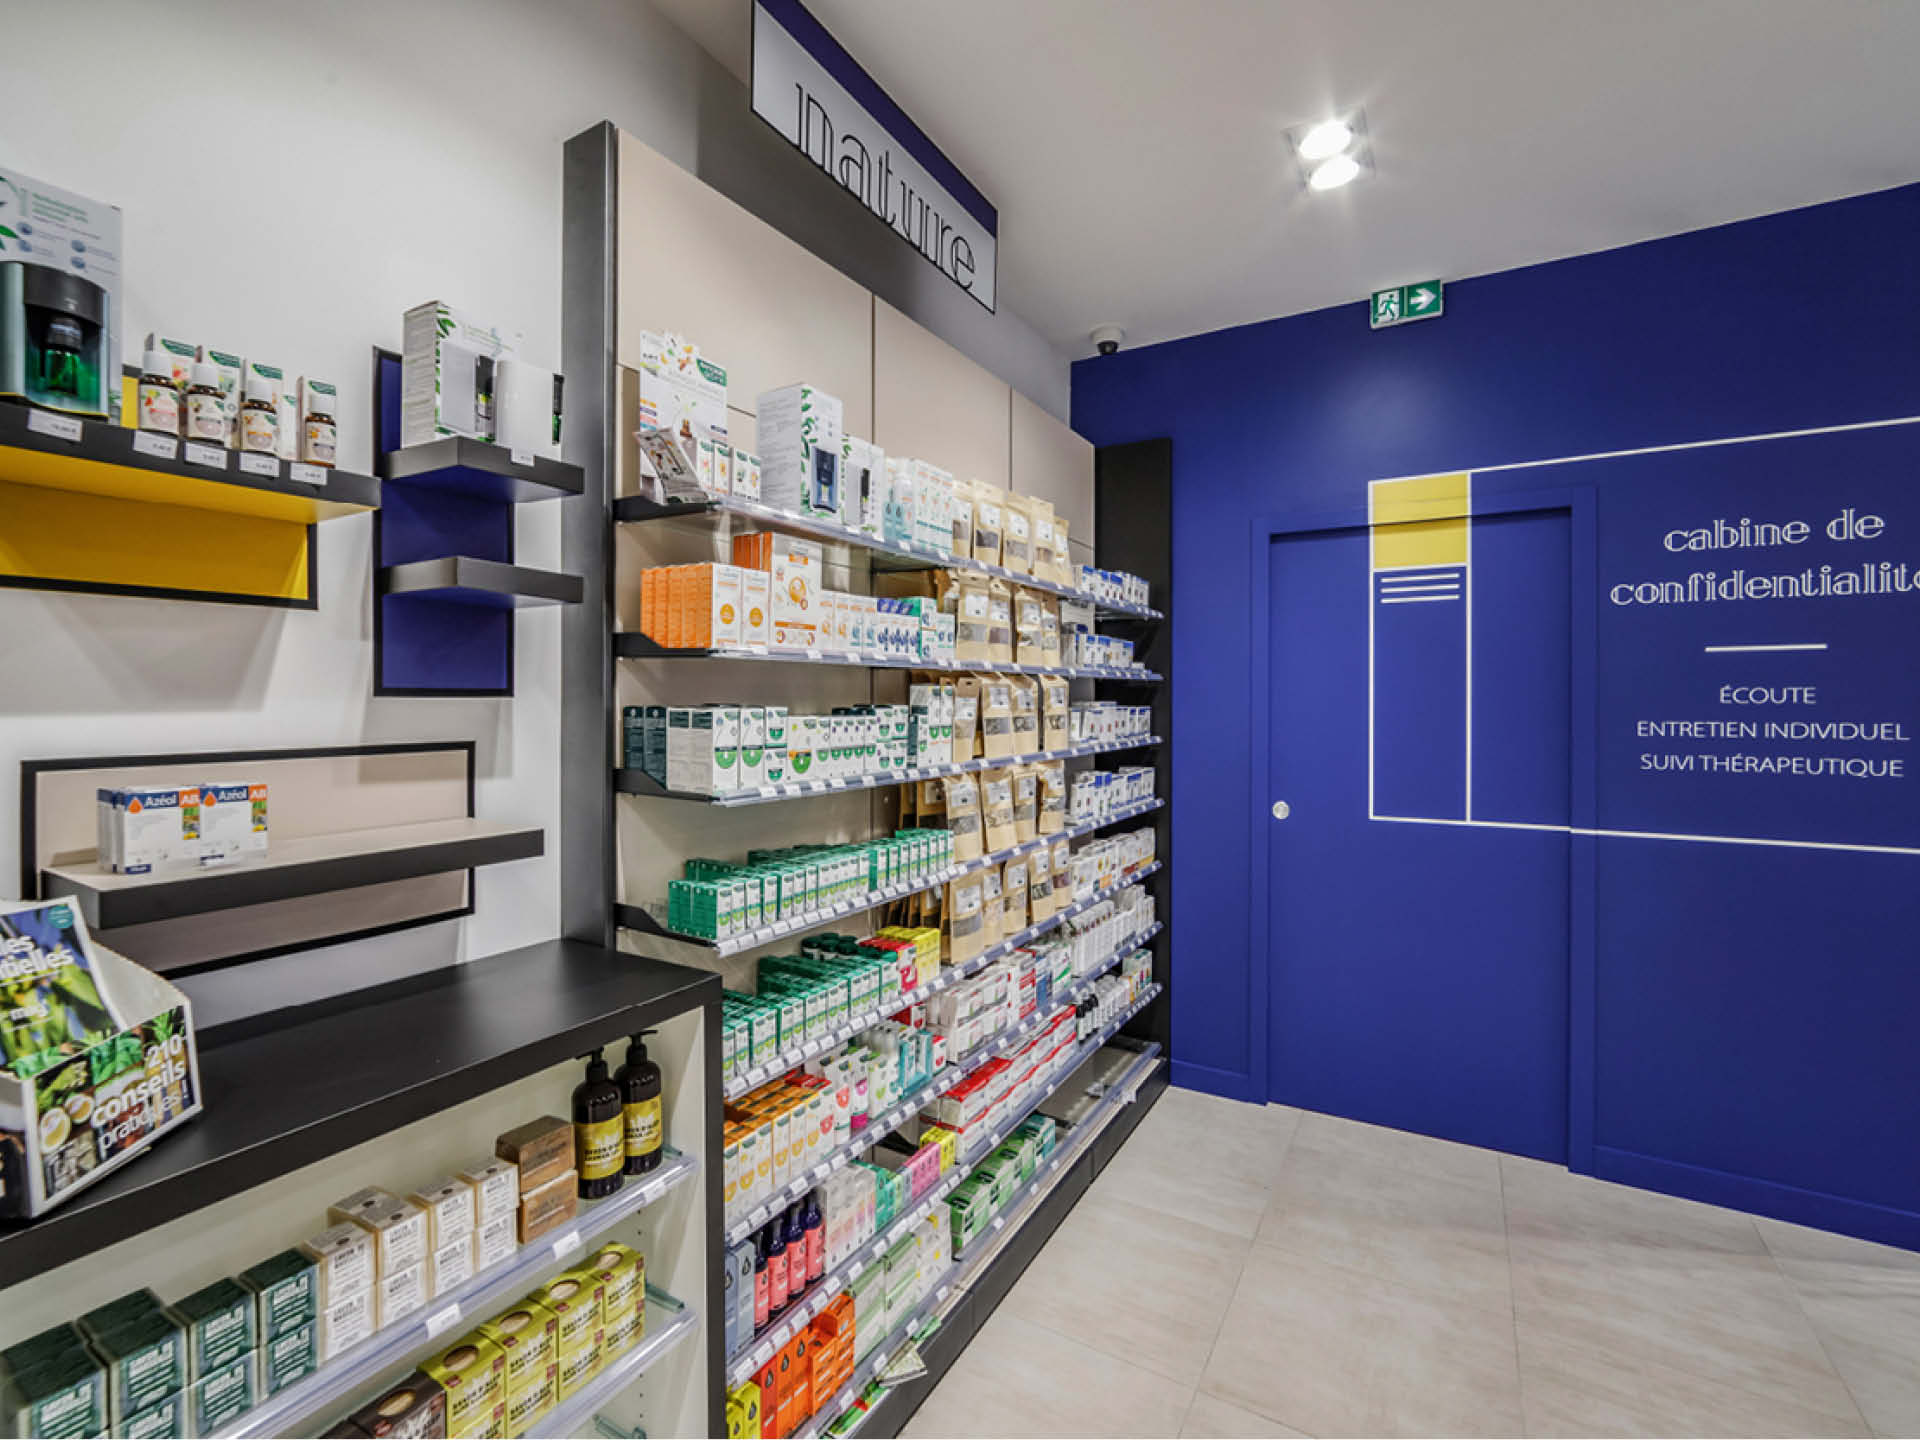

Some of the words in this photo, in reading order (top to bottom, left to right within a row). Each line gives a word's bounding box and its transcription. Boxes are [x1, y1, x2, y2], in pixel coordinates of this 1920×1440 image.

[795, 82, 975, 290] nature
[1664, 517, 1811, 552] cabine
[1826, 508, 1886, 541] de
[1719, 684, 1817, 705] ÉCOUTE
[1637, 720, 1757, 739] ENTRETIEN
[1764, 721, 1910, 741] INDIVIDUEL
[1640, 753, 1694, 772] SUIVI
[1699, 753, 1906, 778] THÉRAPEUTIQUE
[147, 1034, 183, 1066] 210
[90, 1057, 186, 1129] conseils
